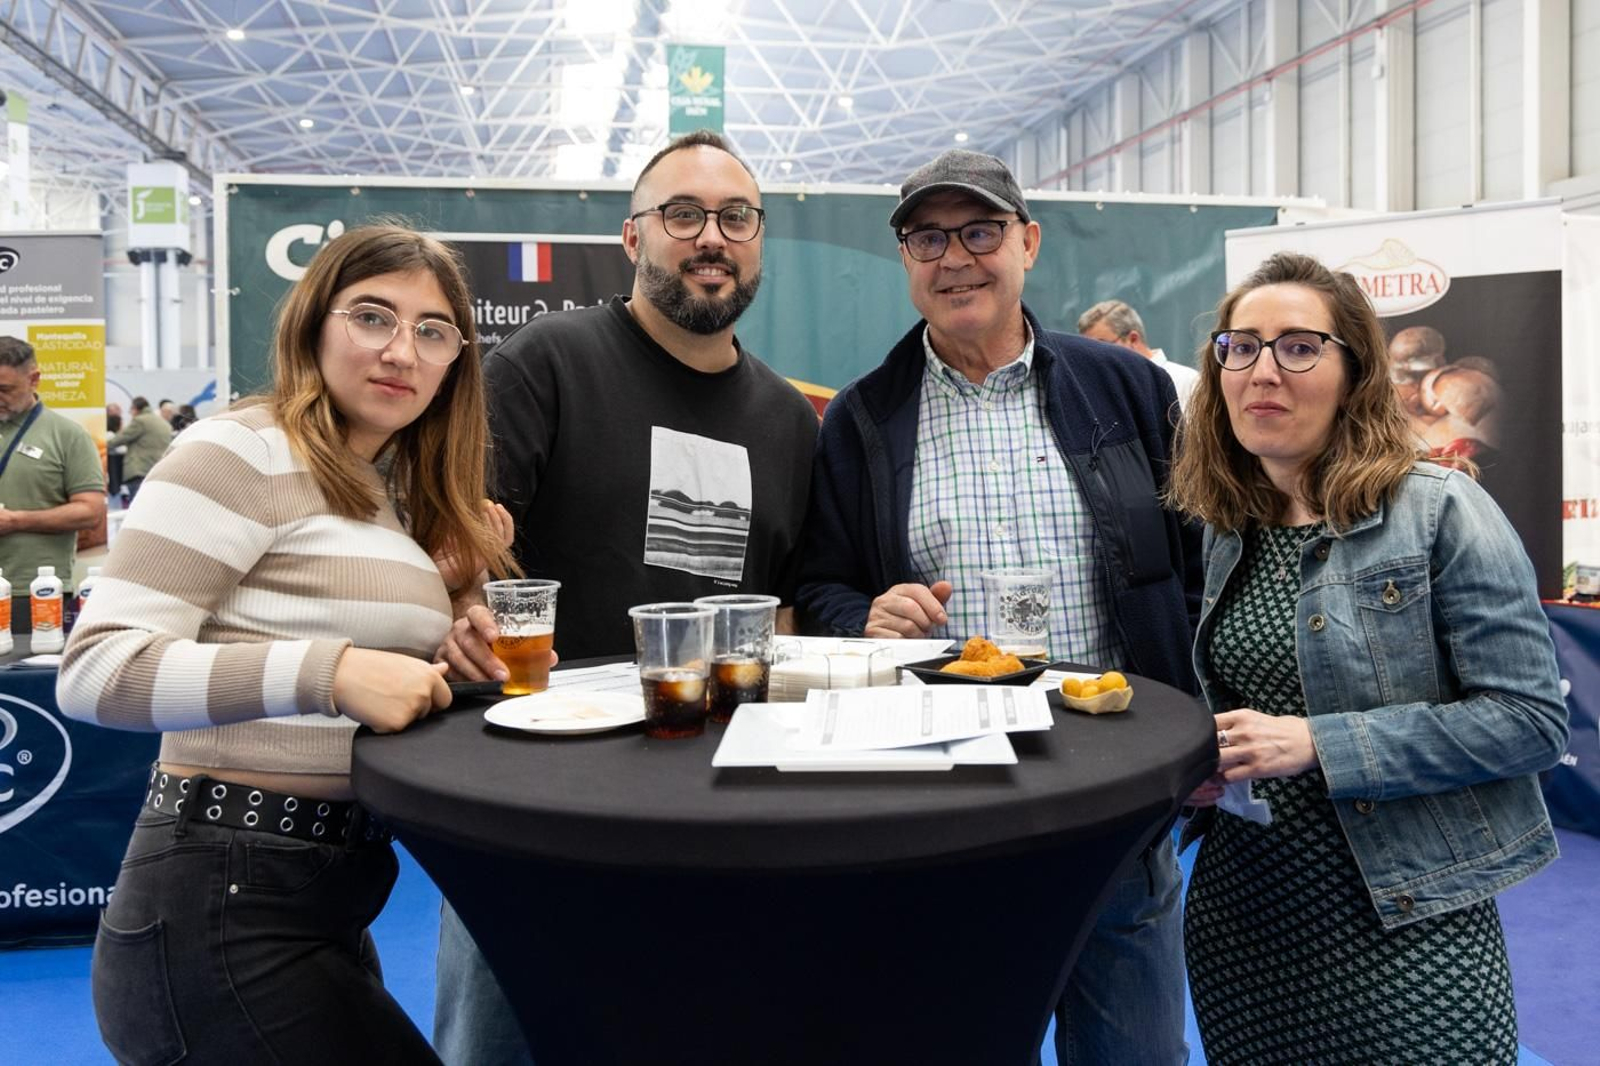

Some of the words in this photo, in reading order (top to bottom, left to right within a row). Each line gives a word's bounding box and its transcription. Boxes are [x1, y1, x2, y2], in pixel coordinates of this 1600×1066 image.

[9, 284, 62, 295] profesional
[1357, 272, 1441, 298] METRA
[10, 295, 33, 304] nivel
[34, 295, 47, 304] de
[48, 293, 94, 305] exigencia
[21, 304, 65, 316] pastelero
[38, 362, 98, 373] NATURAL
